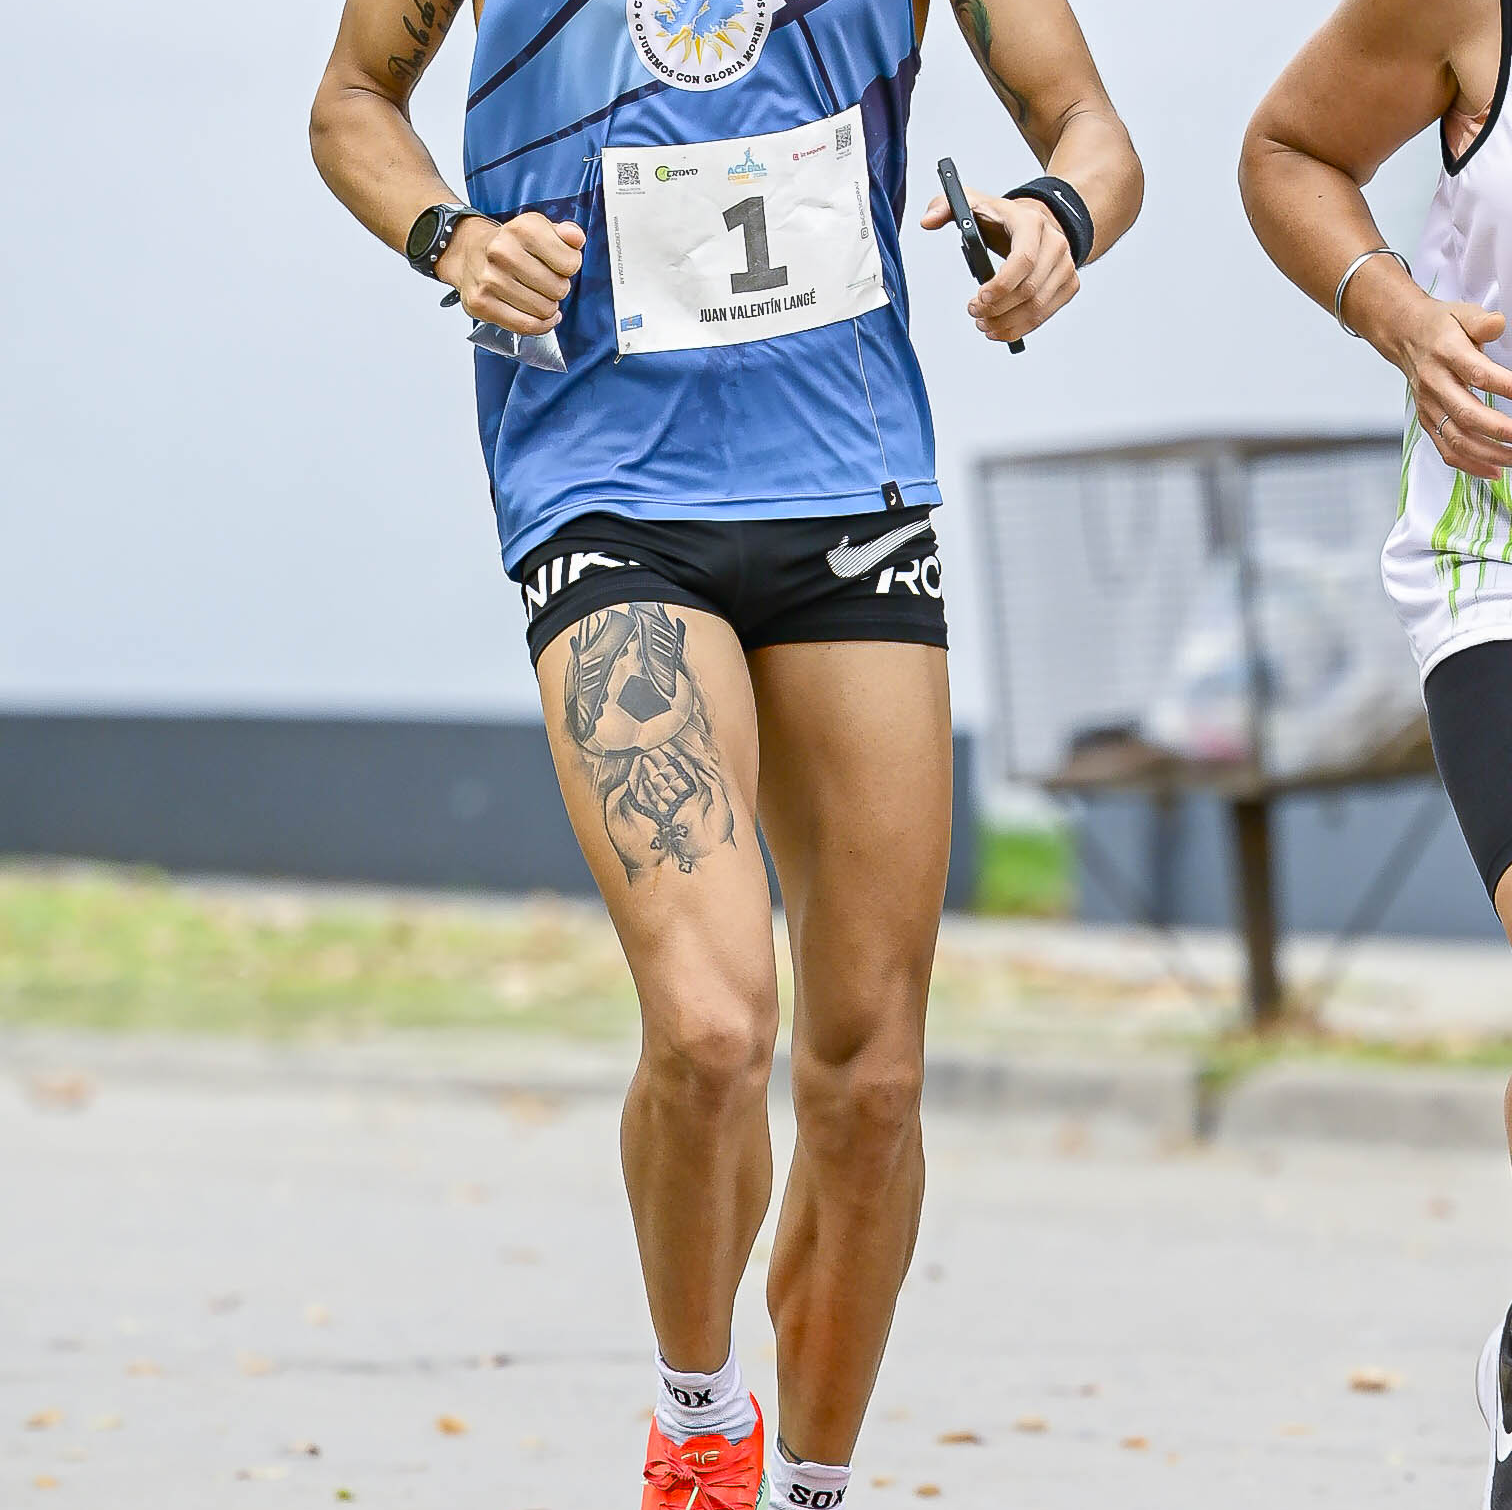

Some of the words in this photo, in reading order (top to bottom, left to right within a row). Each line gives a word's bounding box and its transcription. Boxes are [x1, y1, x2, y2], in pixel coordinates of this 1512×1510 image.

[635, 23, 644, 32] O
[638, 35, 675, 78] JUREMOS
[704, 60, 745, 84] GLORIA
[676, 72, 700, 84] CON
[722, 196, 788, 294] 1
[699, 308, 727, 323] JUAN
[729, 297, 782, 320] VALENTÍN
[784, 287, 817, 311] LANGÉ
[525, 551, 641, 624] NIK
